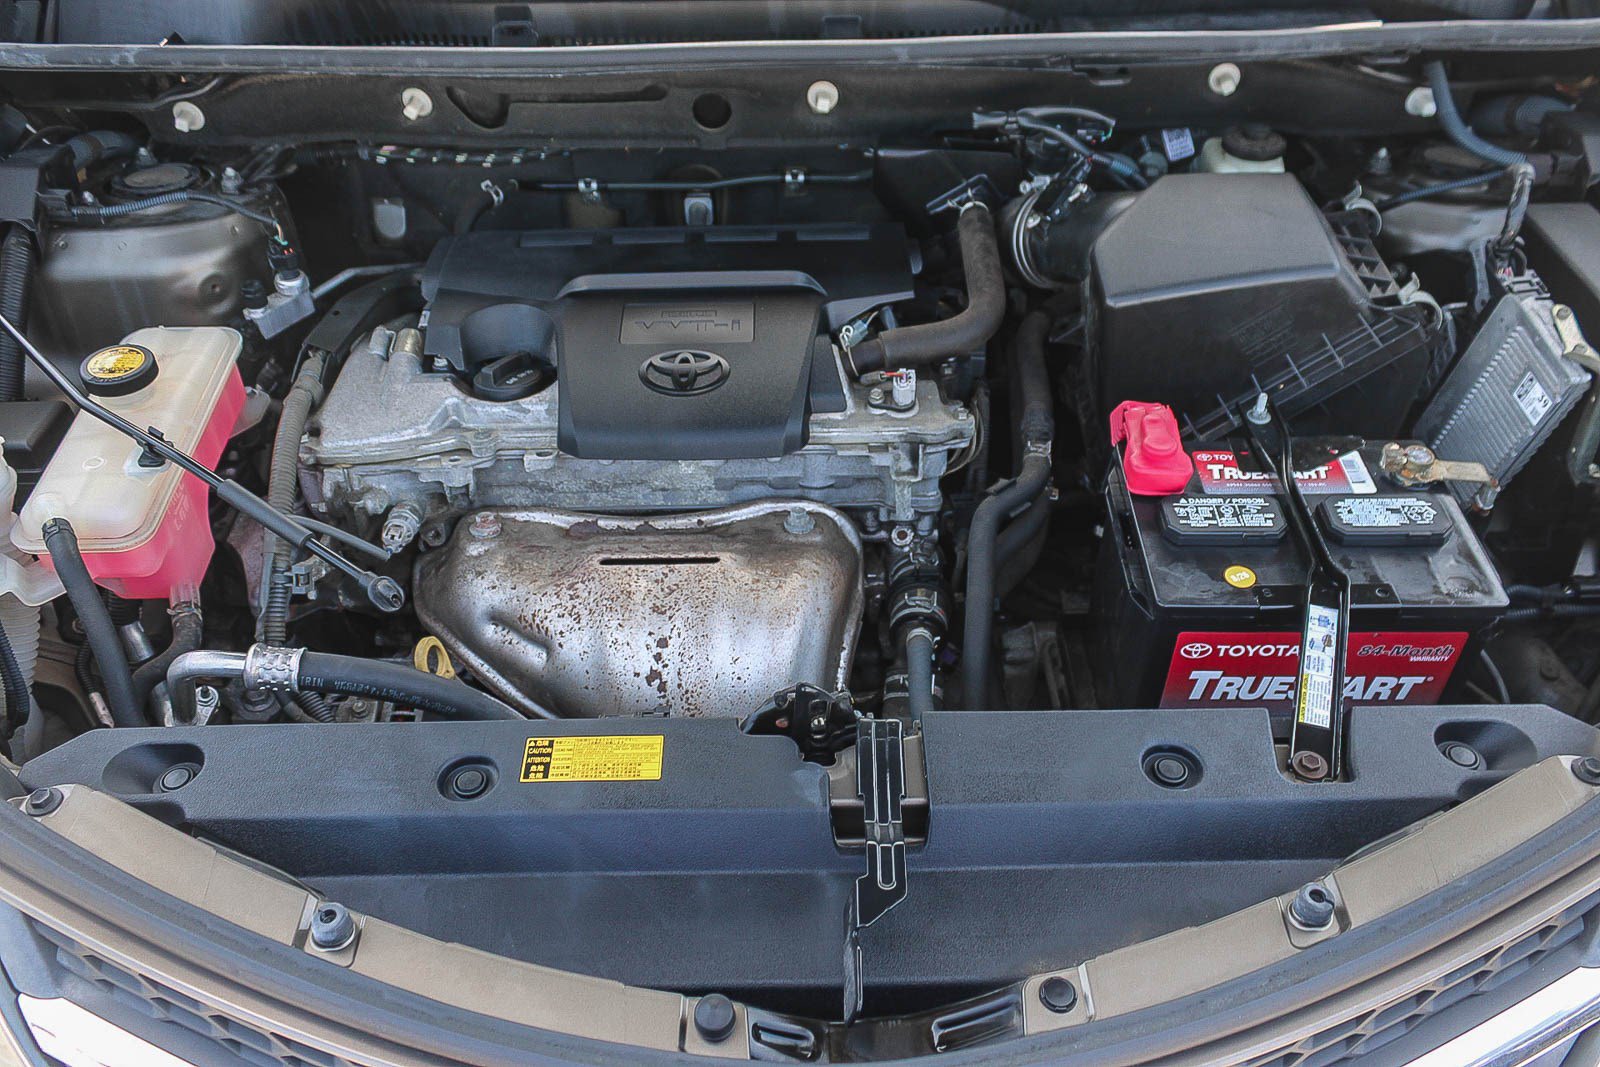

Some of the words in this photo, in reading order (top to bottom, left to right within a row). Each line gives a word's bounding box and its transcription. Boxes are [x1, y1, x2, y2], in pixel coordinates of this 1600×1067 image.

[1213, 453, 1234, 461] TOY
[1217, 644, 1300, 657] TOYOTA
[1357, 645, 1455, 657] 84-Month
[1188, 670, 1426, 700] TRUEART
